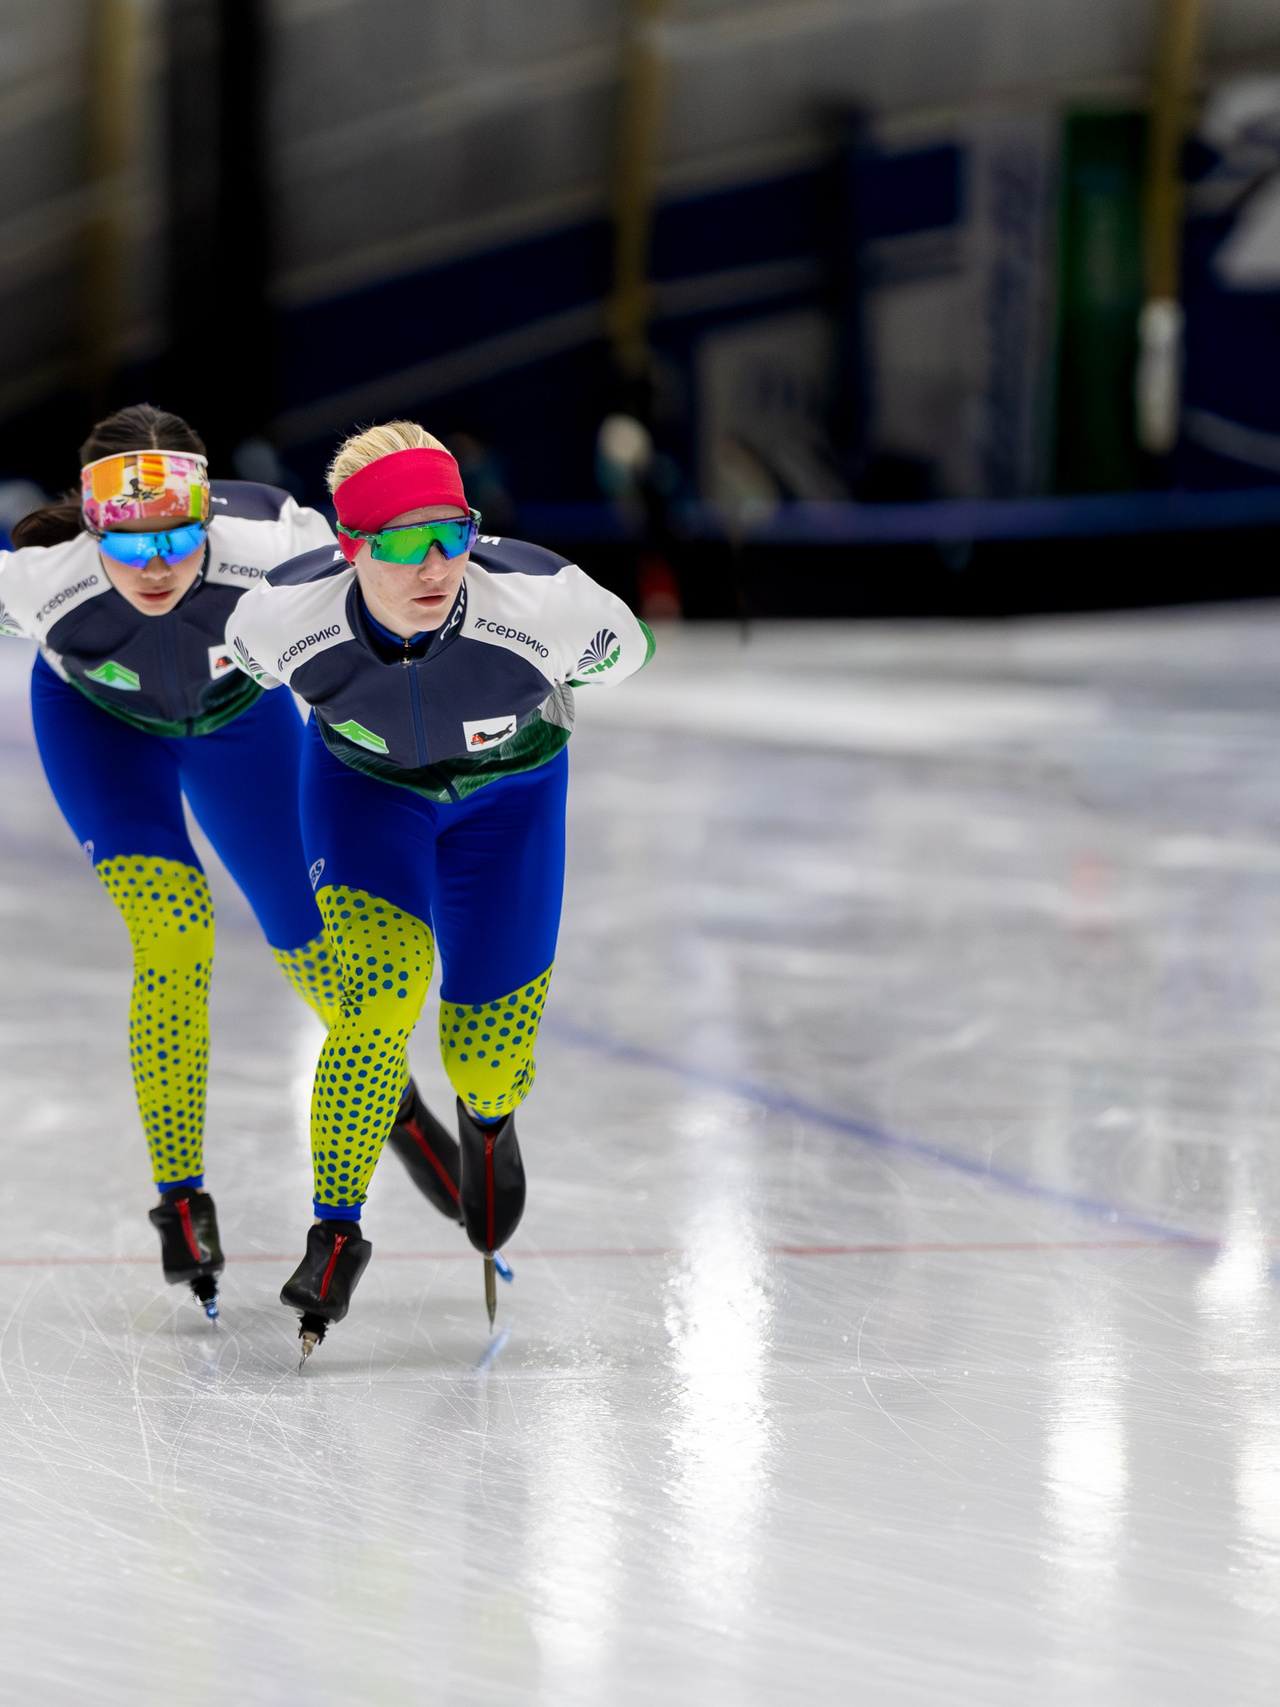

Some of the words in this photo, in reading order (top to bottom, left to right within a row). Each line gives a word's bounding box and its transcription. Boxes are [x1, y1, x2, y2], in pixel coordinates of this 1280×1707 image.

[42, 574, 99, 615] сервико
[282, 624, 341, 663] сервико
[486, 621, 550, 659] сервико
